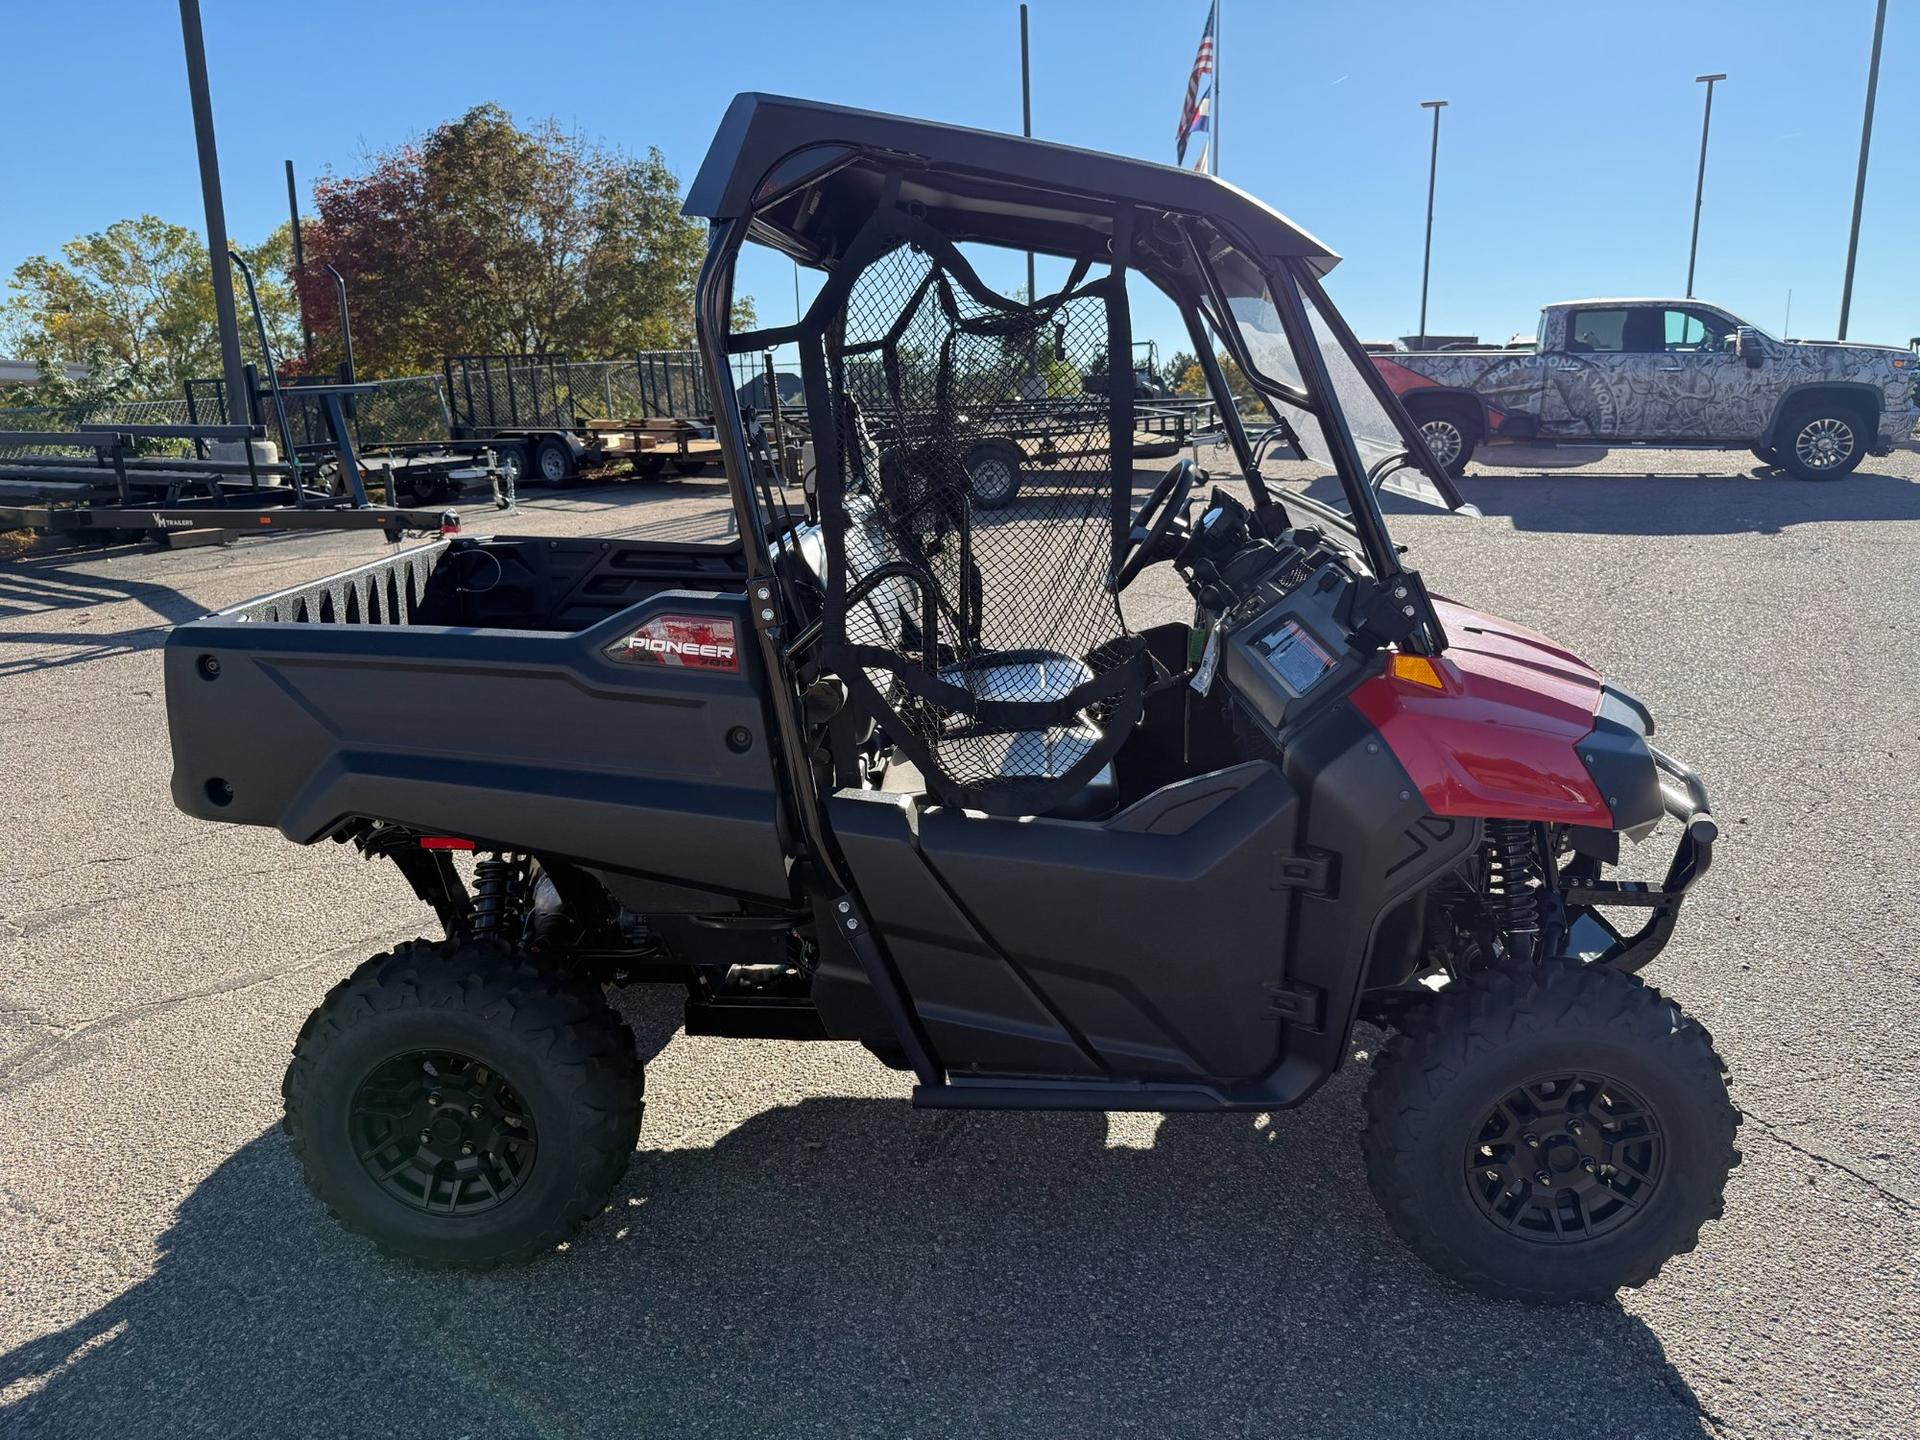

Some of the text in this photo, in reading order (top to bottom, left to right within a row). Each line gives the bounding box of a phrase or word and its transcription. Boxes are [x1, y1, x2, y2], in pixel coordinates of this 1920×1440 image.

[1488, 356, 1532, 384] PEAK
[1590, 377, 1614, 433] WORLD
[629, 637, 734, 658] PIONEER
